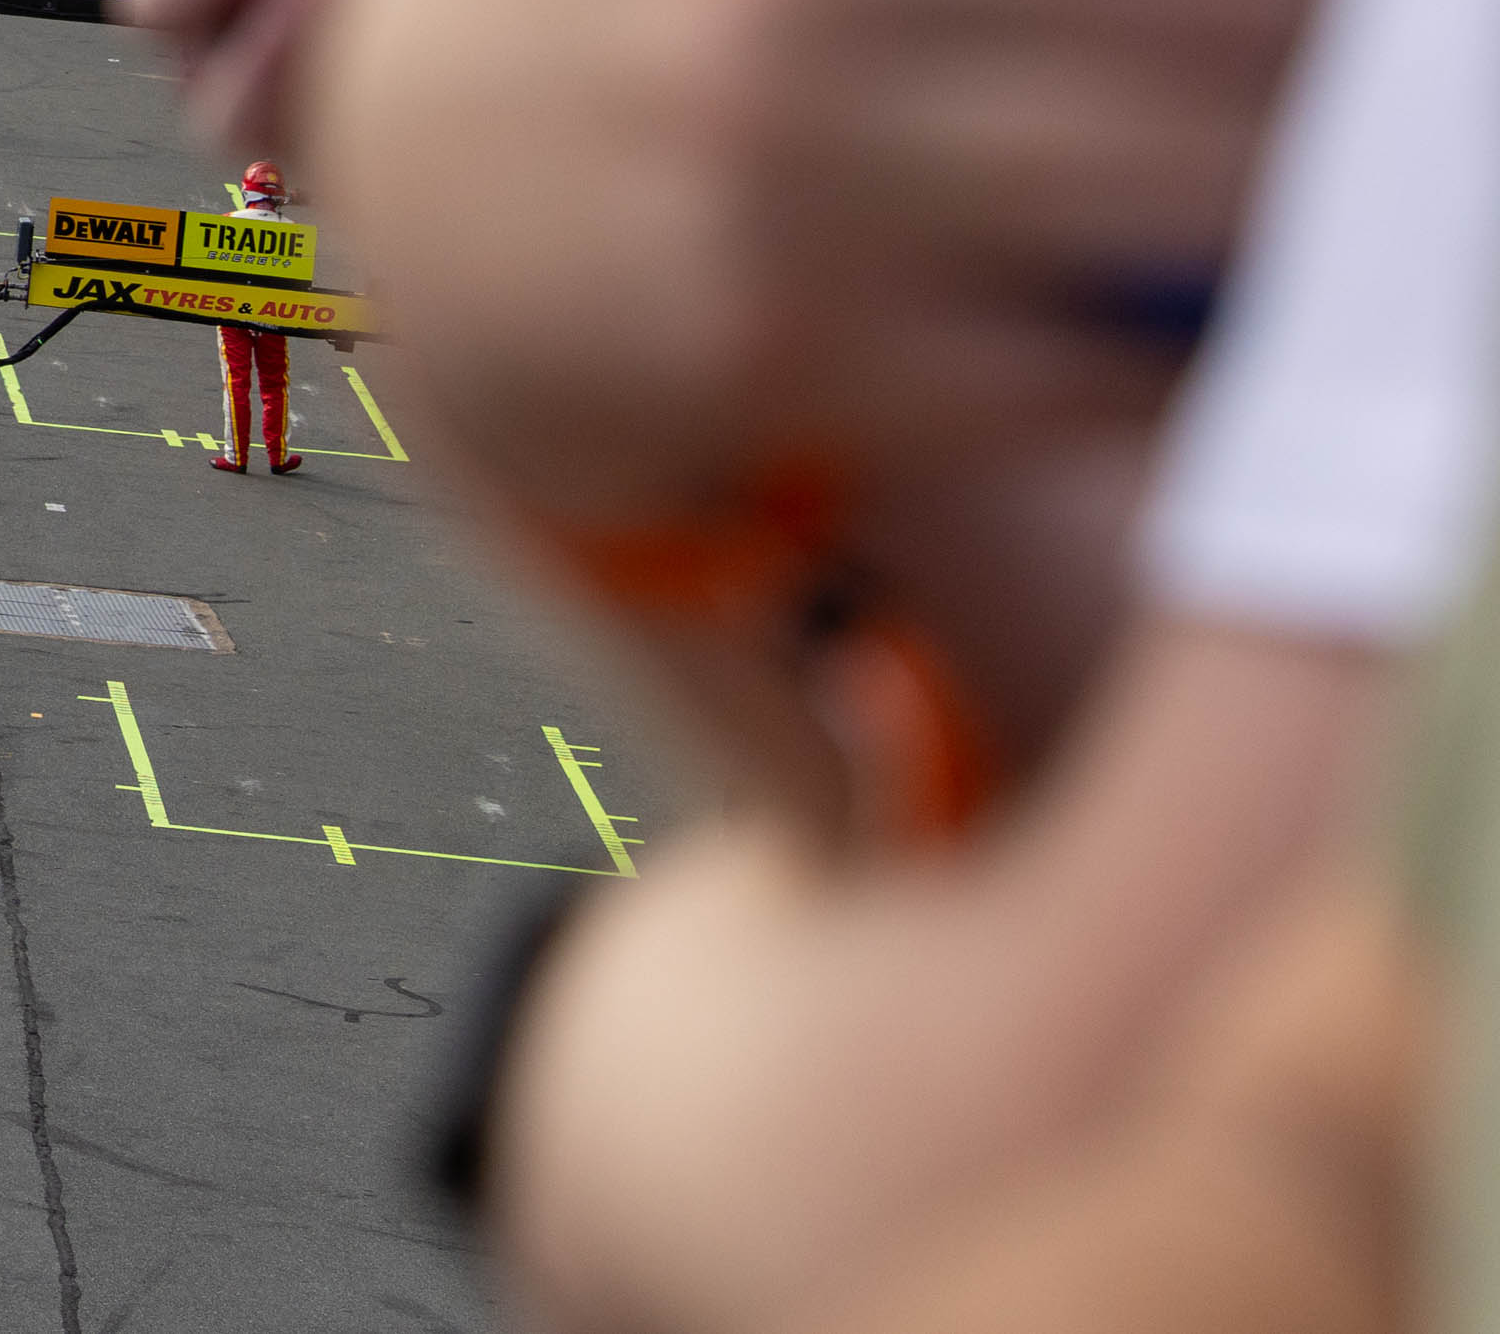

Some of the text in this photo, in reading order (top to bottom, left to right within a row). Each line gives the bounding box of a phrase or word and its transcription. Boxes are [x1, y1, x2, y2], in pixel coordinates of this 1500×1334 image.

[199, 222, 304, 259] TRADIE
[52, 276, 336, 324] JAX TYRES & AUTO
